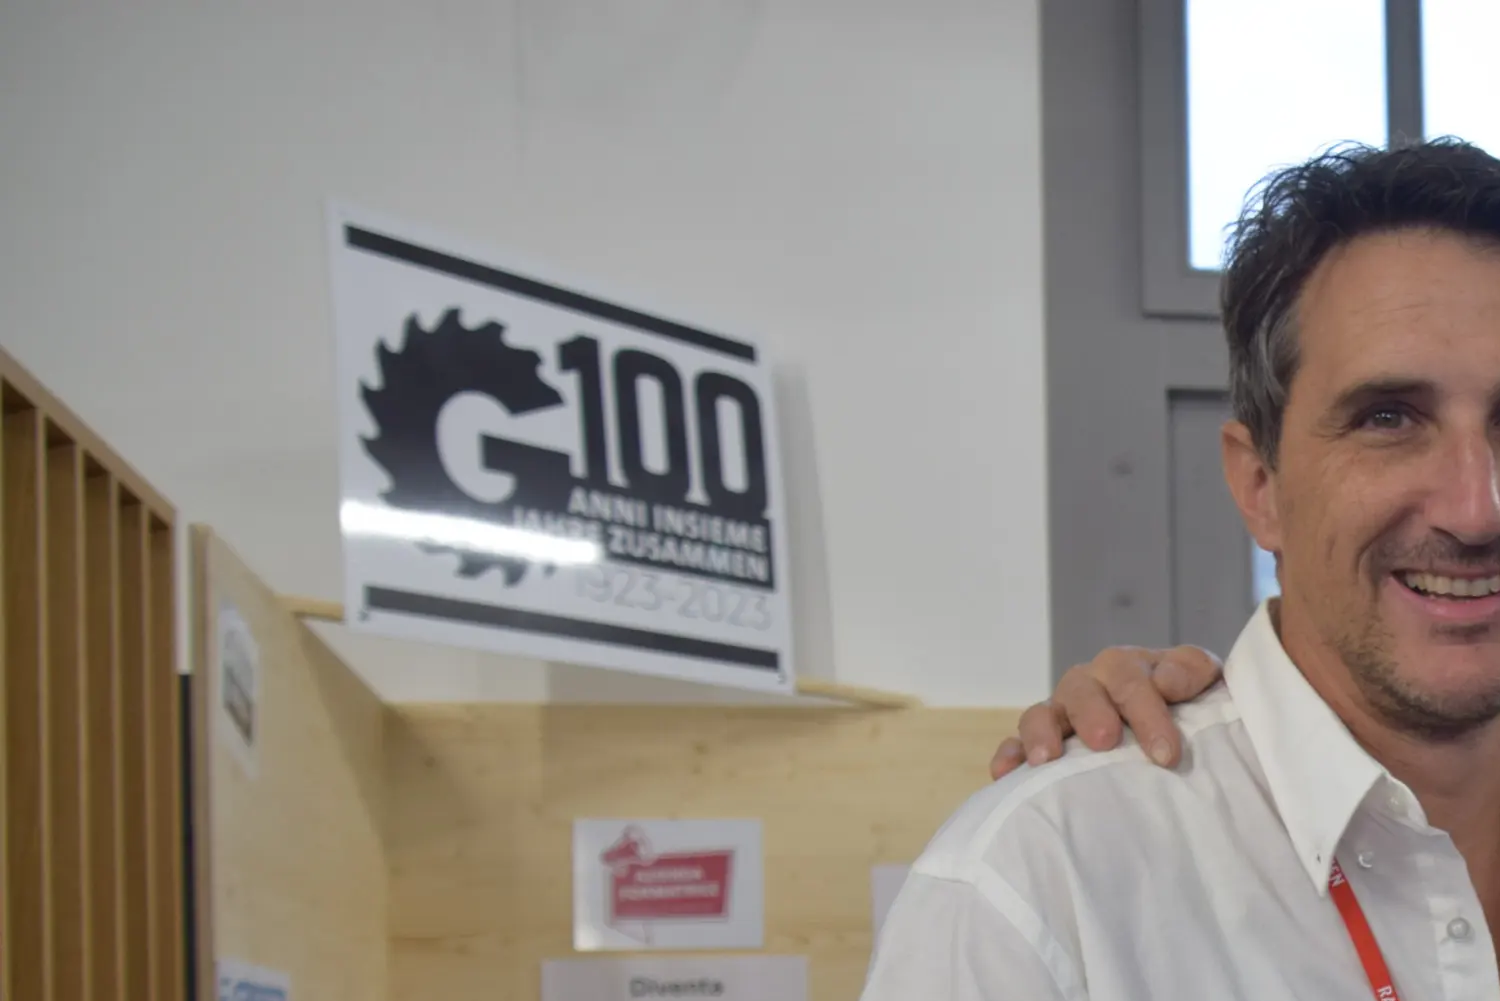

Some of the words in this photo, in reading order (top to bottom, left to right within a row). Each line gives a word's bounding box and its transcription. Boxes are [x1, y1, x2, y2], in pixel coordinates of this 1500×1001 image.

[556, 333, 769, 508] 100
[567, 485, 648, 528] ANNI
[652, 503, 768, 553] INSIEME
[607, 525, 770, 583] ZUSAMMEN
[629, 976, 725, 998] Diventa
